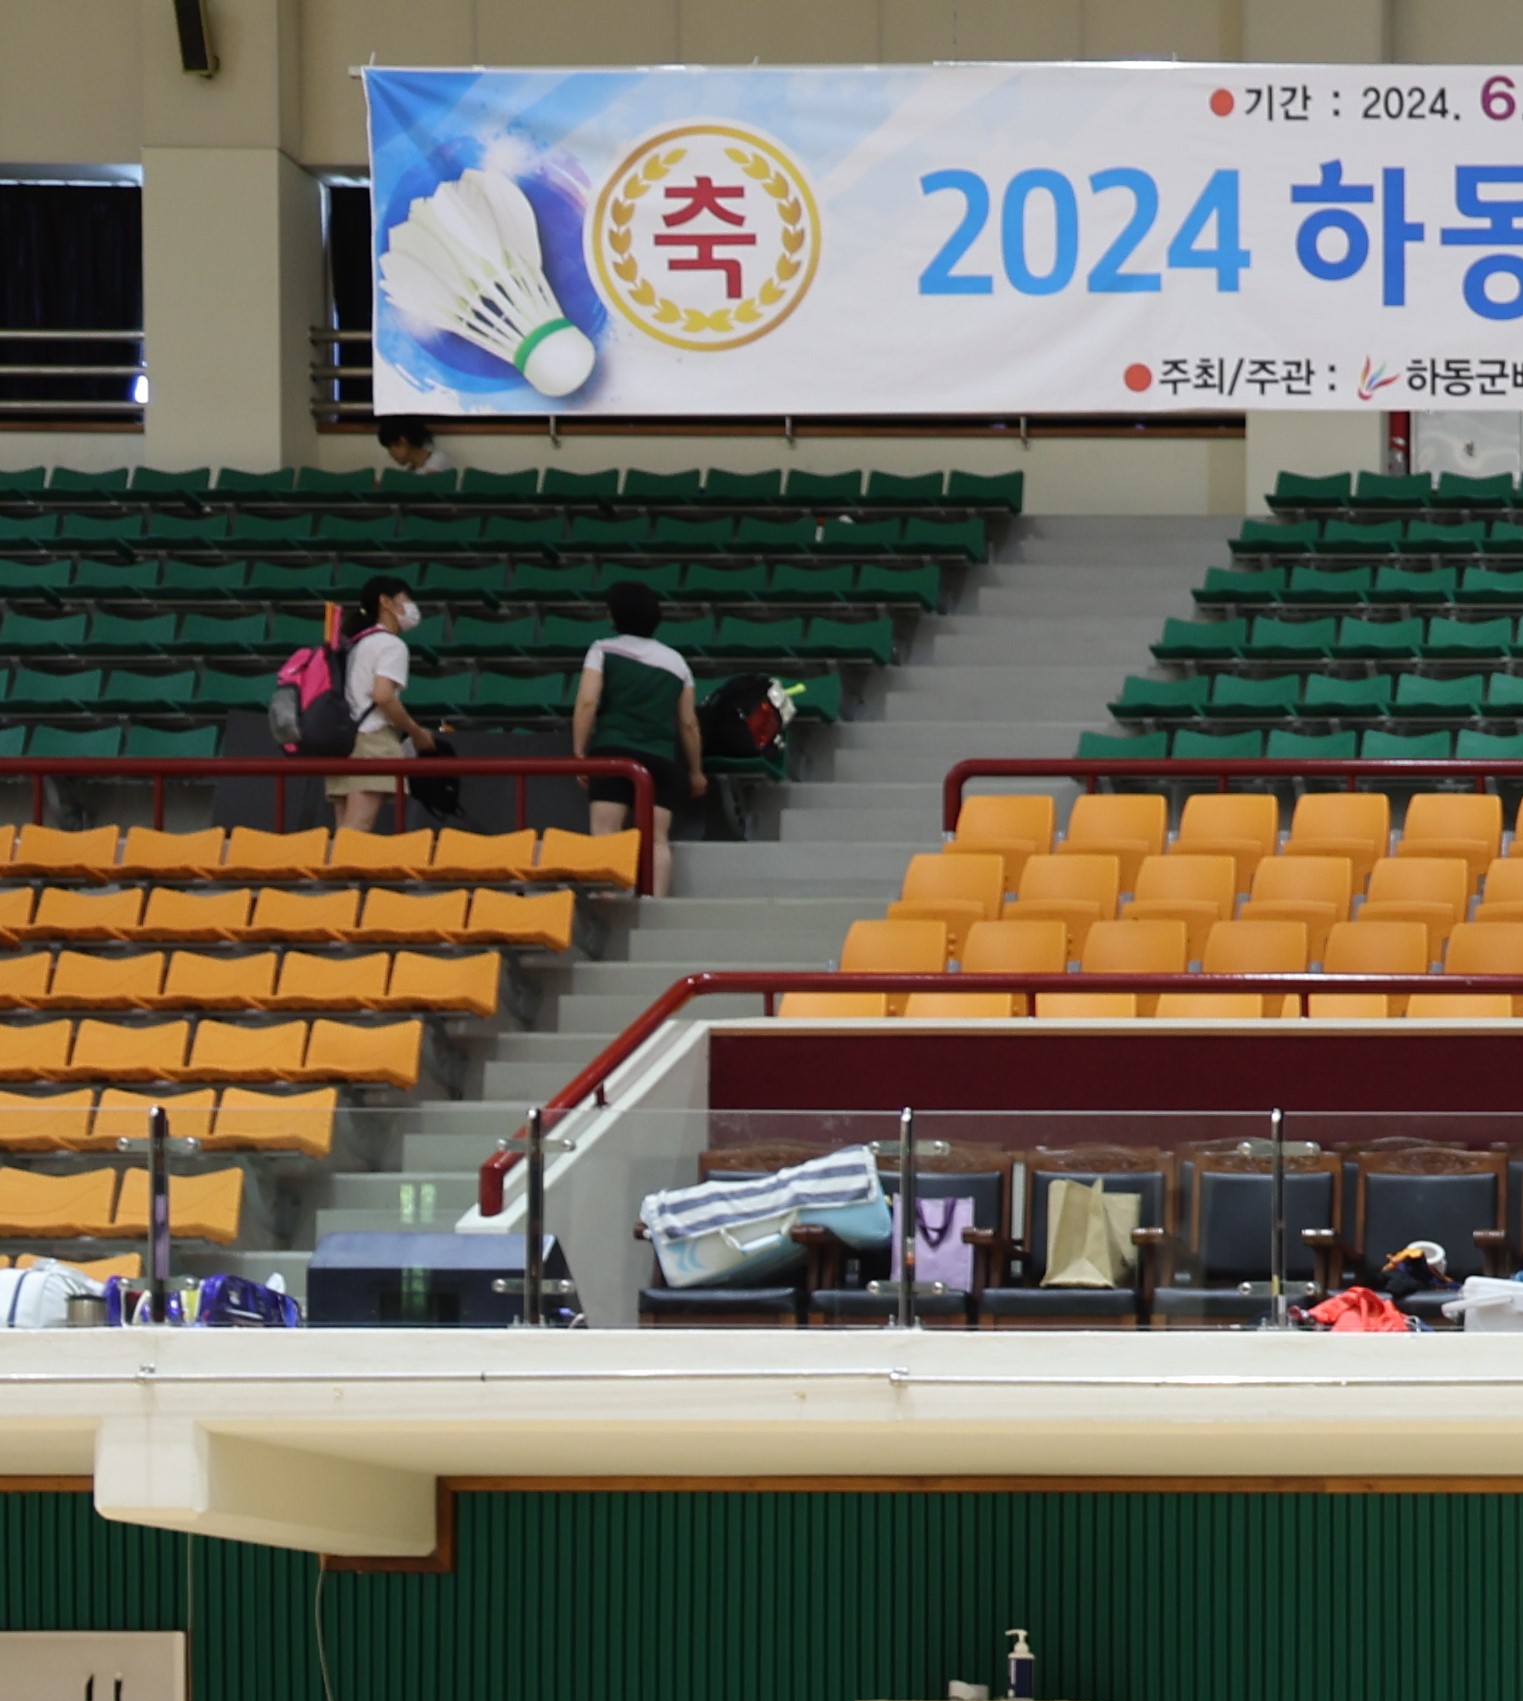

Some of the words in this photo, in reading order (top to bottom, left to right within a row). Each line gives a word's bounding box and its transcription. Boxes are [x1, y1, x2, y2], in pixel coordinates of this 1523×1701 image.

[1244, 84, 1312, 122] 기간
[1361, 86, 1461, 122] 2024.
[653, 175, 757, 300] 축
[918, 166, 1252, 297] 2024
[1158, 357, 1316, 397] 주최/주관
